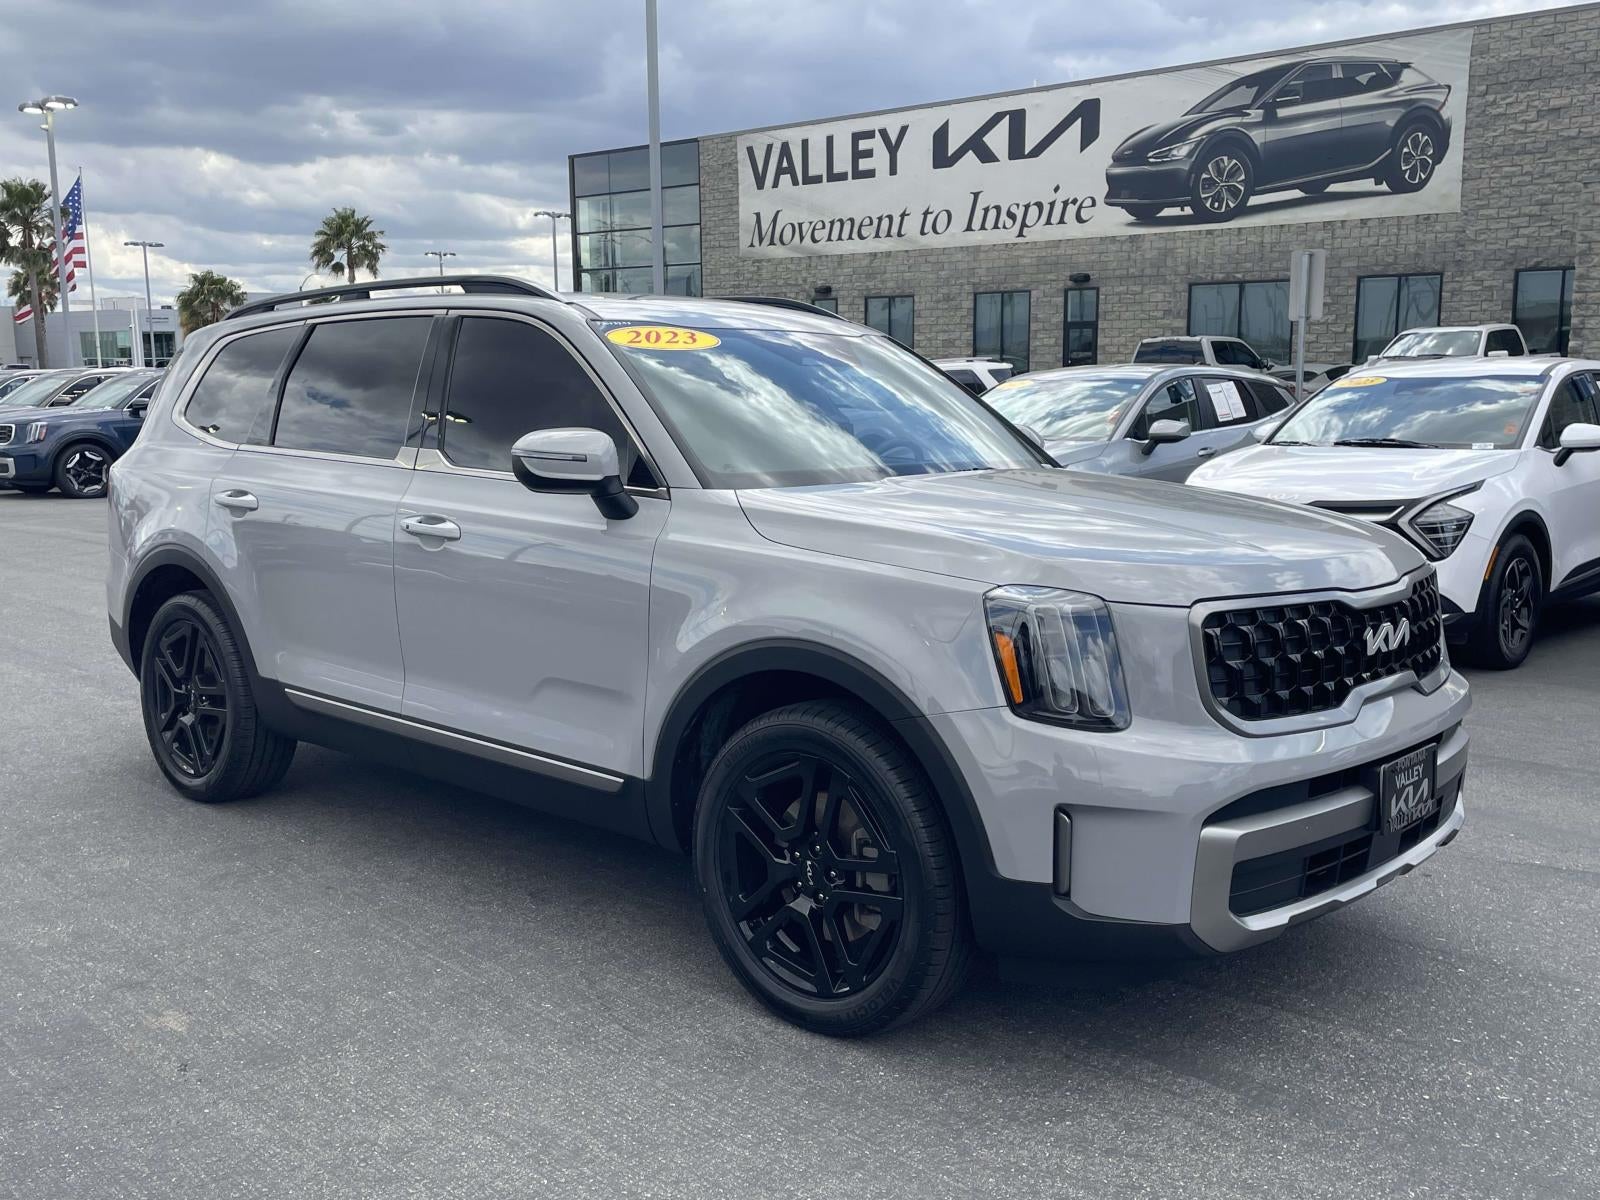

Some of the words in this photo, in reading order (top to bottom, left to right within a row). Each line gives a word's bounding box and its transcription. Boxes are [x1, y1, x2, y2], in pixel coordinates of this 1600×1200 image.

[746, 124, 909, 190] VALLEY
[748, 205, 911, 249] Movement
[919, 205, 953, 237] to
[962, 184, 1097, 238] Inspire
[626, 330, 698, 345] 2023
[1395, 763, 1424, 789] VALLEY
